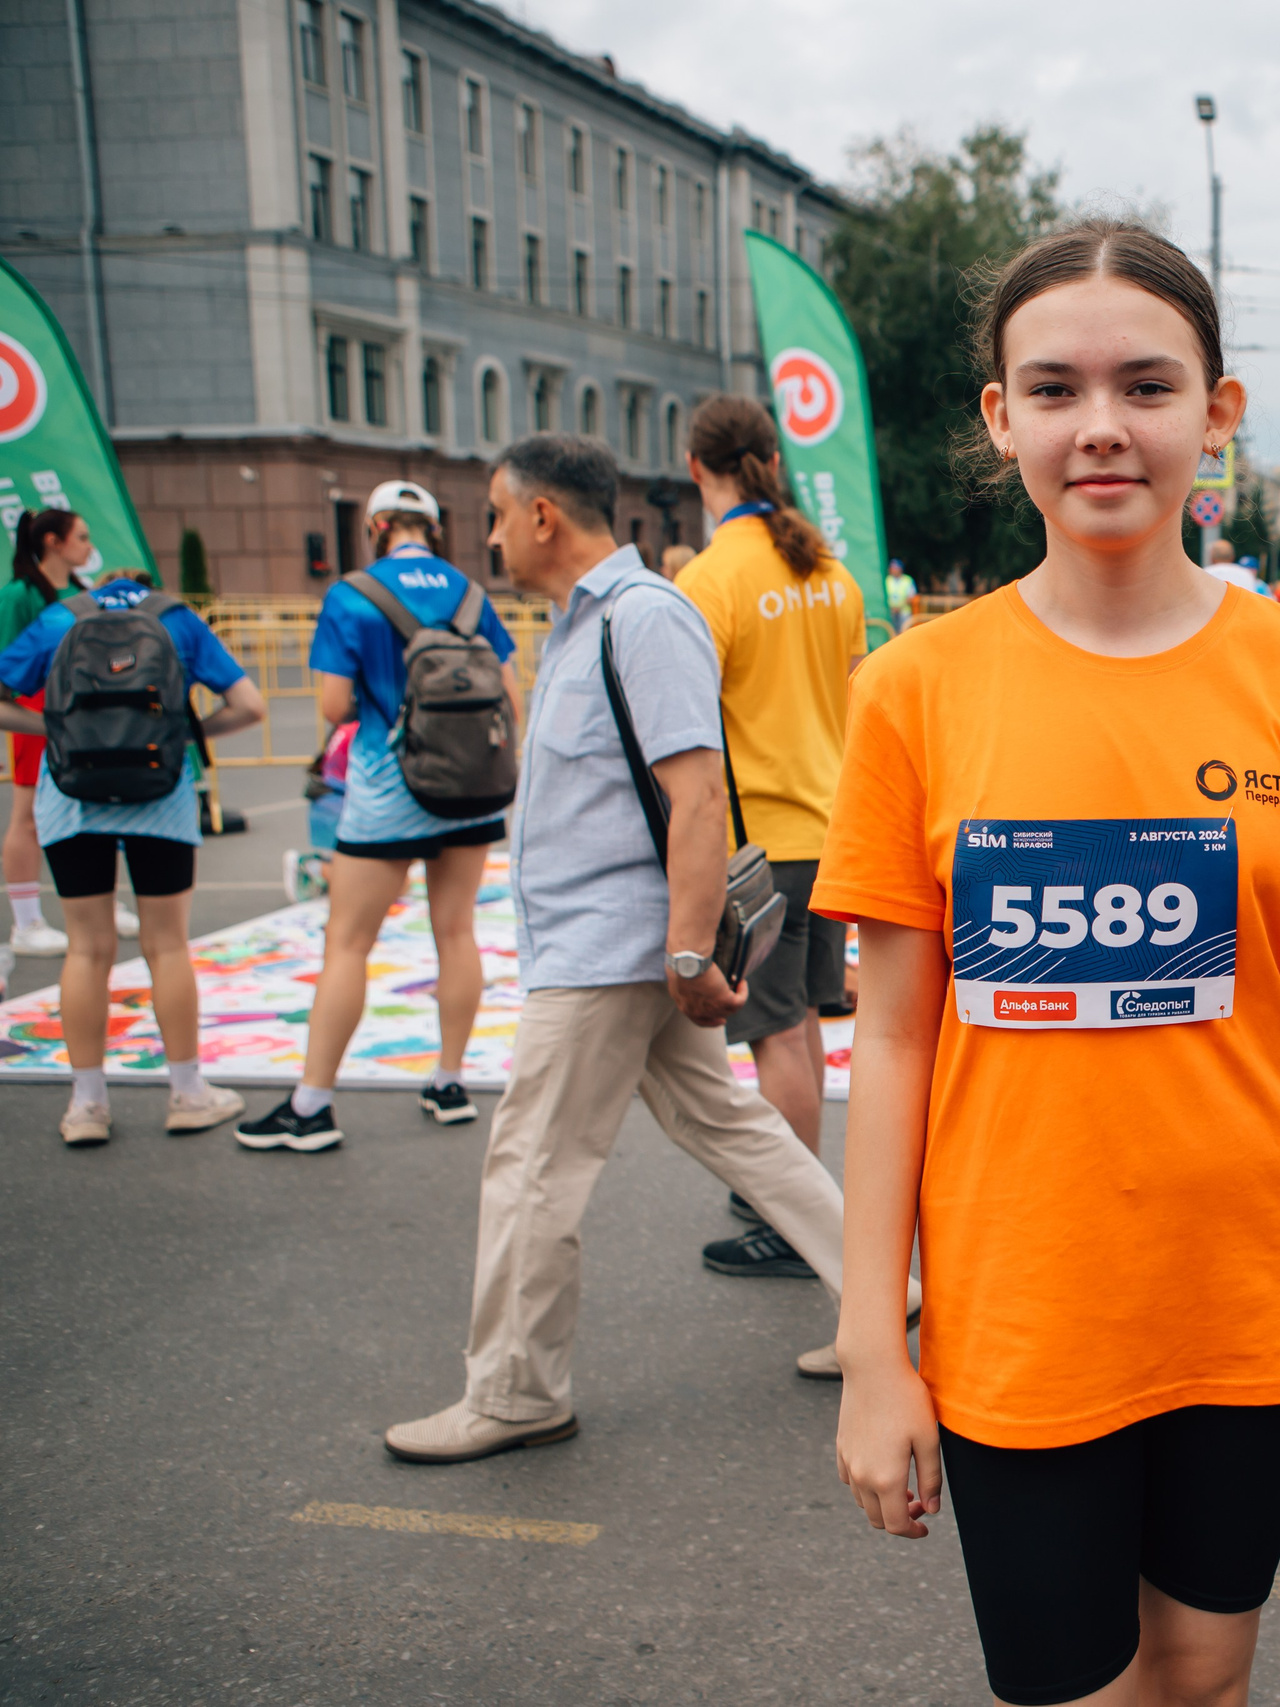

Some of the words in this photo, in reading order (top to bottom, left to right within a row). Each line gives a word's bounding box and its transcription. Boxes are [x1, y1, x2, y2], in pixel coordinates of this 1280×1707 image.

[1013, 830, 1053, 838] СИБИРСКИЙ
[1129, 832, 1137, 842] 3
[1139, 831, 1196, 841] АВГУСТА
[1198, 830, 1227, 840] 2024
[1212, 843, 1226, 851] КМ
[988, 882, 1199, 949] 5589
[1000, 998, 1037, 1014] Альфа
[1039, 999, 1069, 1011] Банк
[1125, 1000, 1191, 1012] Следопыт
